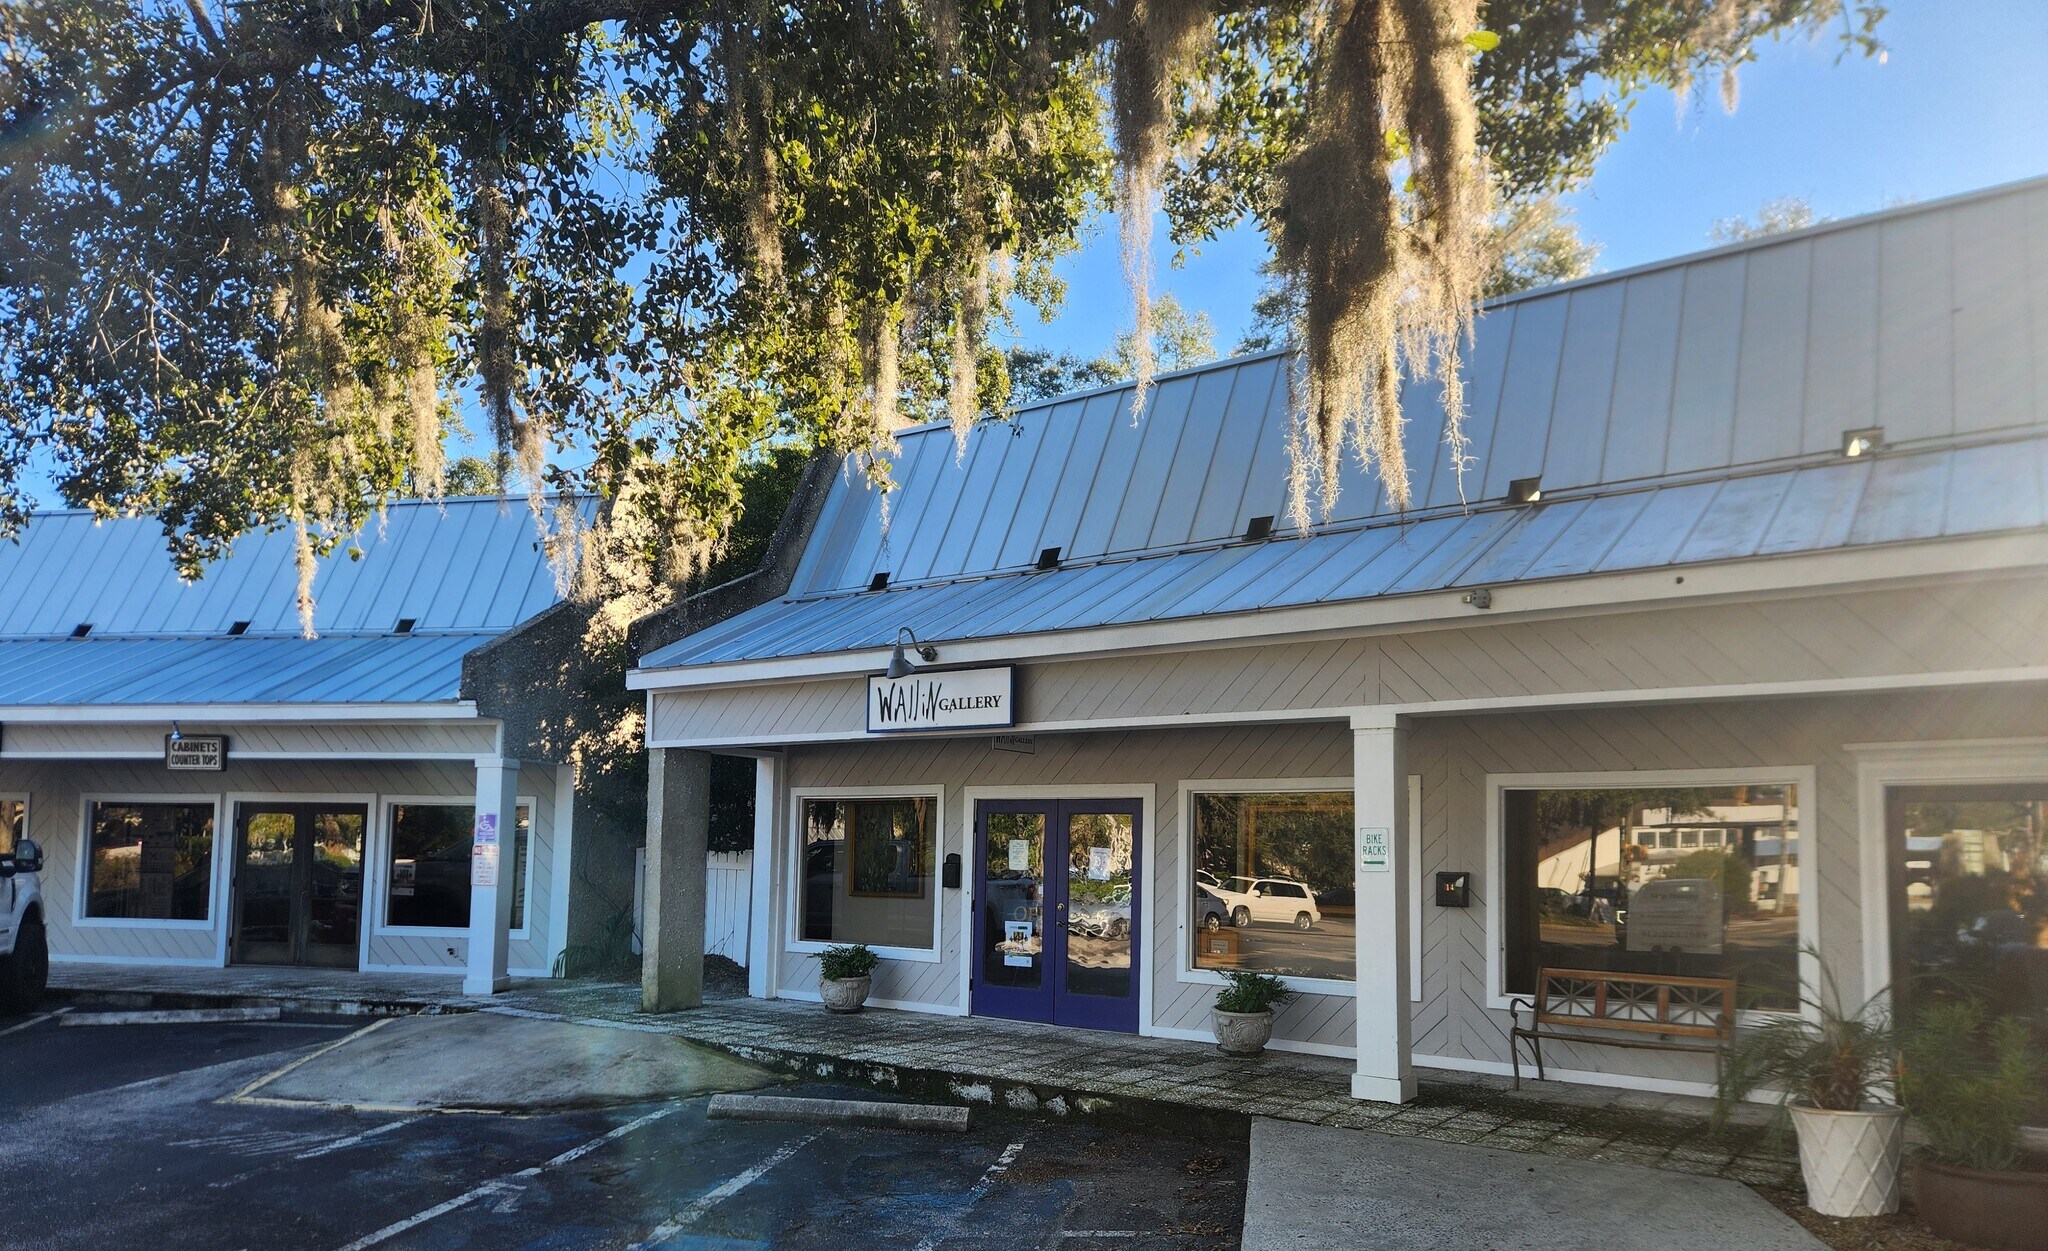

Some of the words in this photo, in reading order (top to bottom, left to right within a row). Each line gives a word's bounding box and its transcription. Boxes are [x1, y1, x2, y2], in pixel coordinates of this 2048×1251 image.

[939, 695, 1002, 713] GALLERY
[172, 742, 218, 752] CABINETS
[171, 754, 200, 765] COUNTER
[202, 755, 217, 765] TOPS
[1366, 834, 1382, 844] BIKE
[1362, 846, 1387, 855] RACKS
